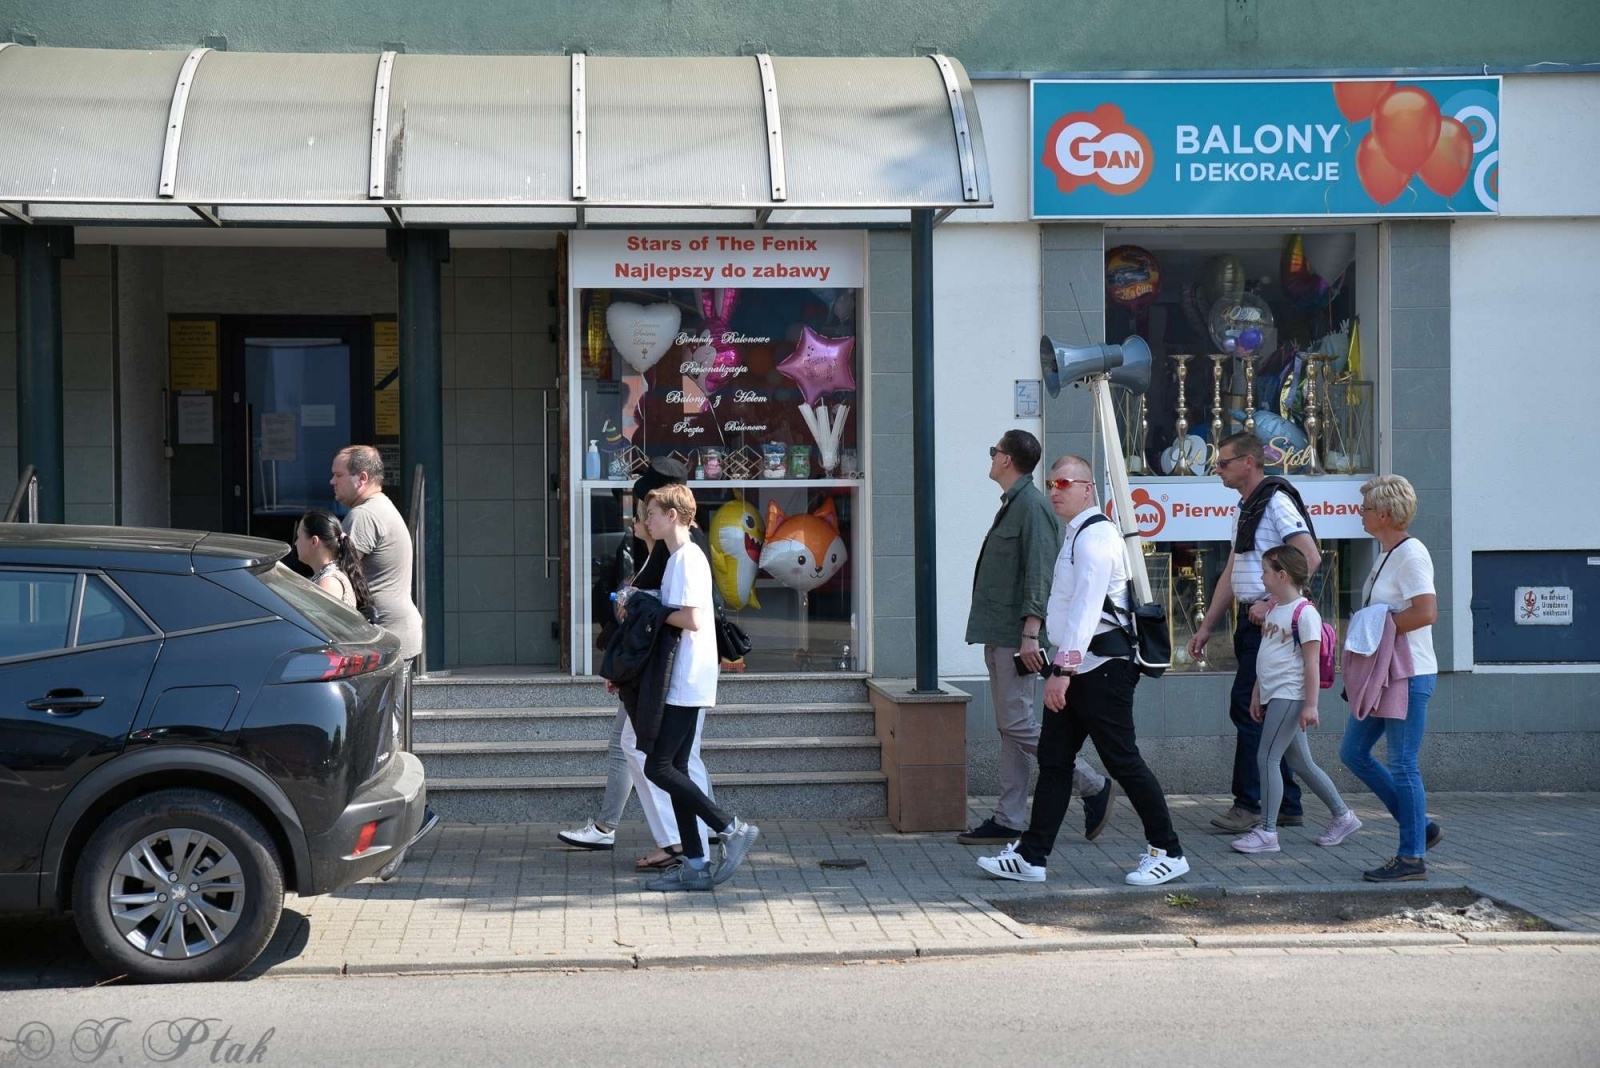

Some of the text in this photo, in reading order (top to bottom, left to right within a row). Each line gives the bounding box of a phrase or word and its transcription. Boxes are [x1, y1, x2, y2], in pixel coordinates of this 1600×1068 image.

[1175, 124, 1341, 155] BALONY
[1175, 162, 1340, 182] I DEKORACJE
[626, 235, 818, 251] Stars of The Fenix
[615, 262, 831, 281] Najlepszy do zabawy
[675, 331, 771, 347] Girlandy Balonowe
[679, 361, 748, 378] Personalizacja
[665, 389, 768, 408] Balony z Helem
[673, 420, 767, 437] Poczta Balonowa
[1171, 503, 1237, 518] Pierws
[1303, 500, 1361, 516] zabaw
